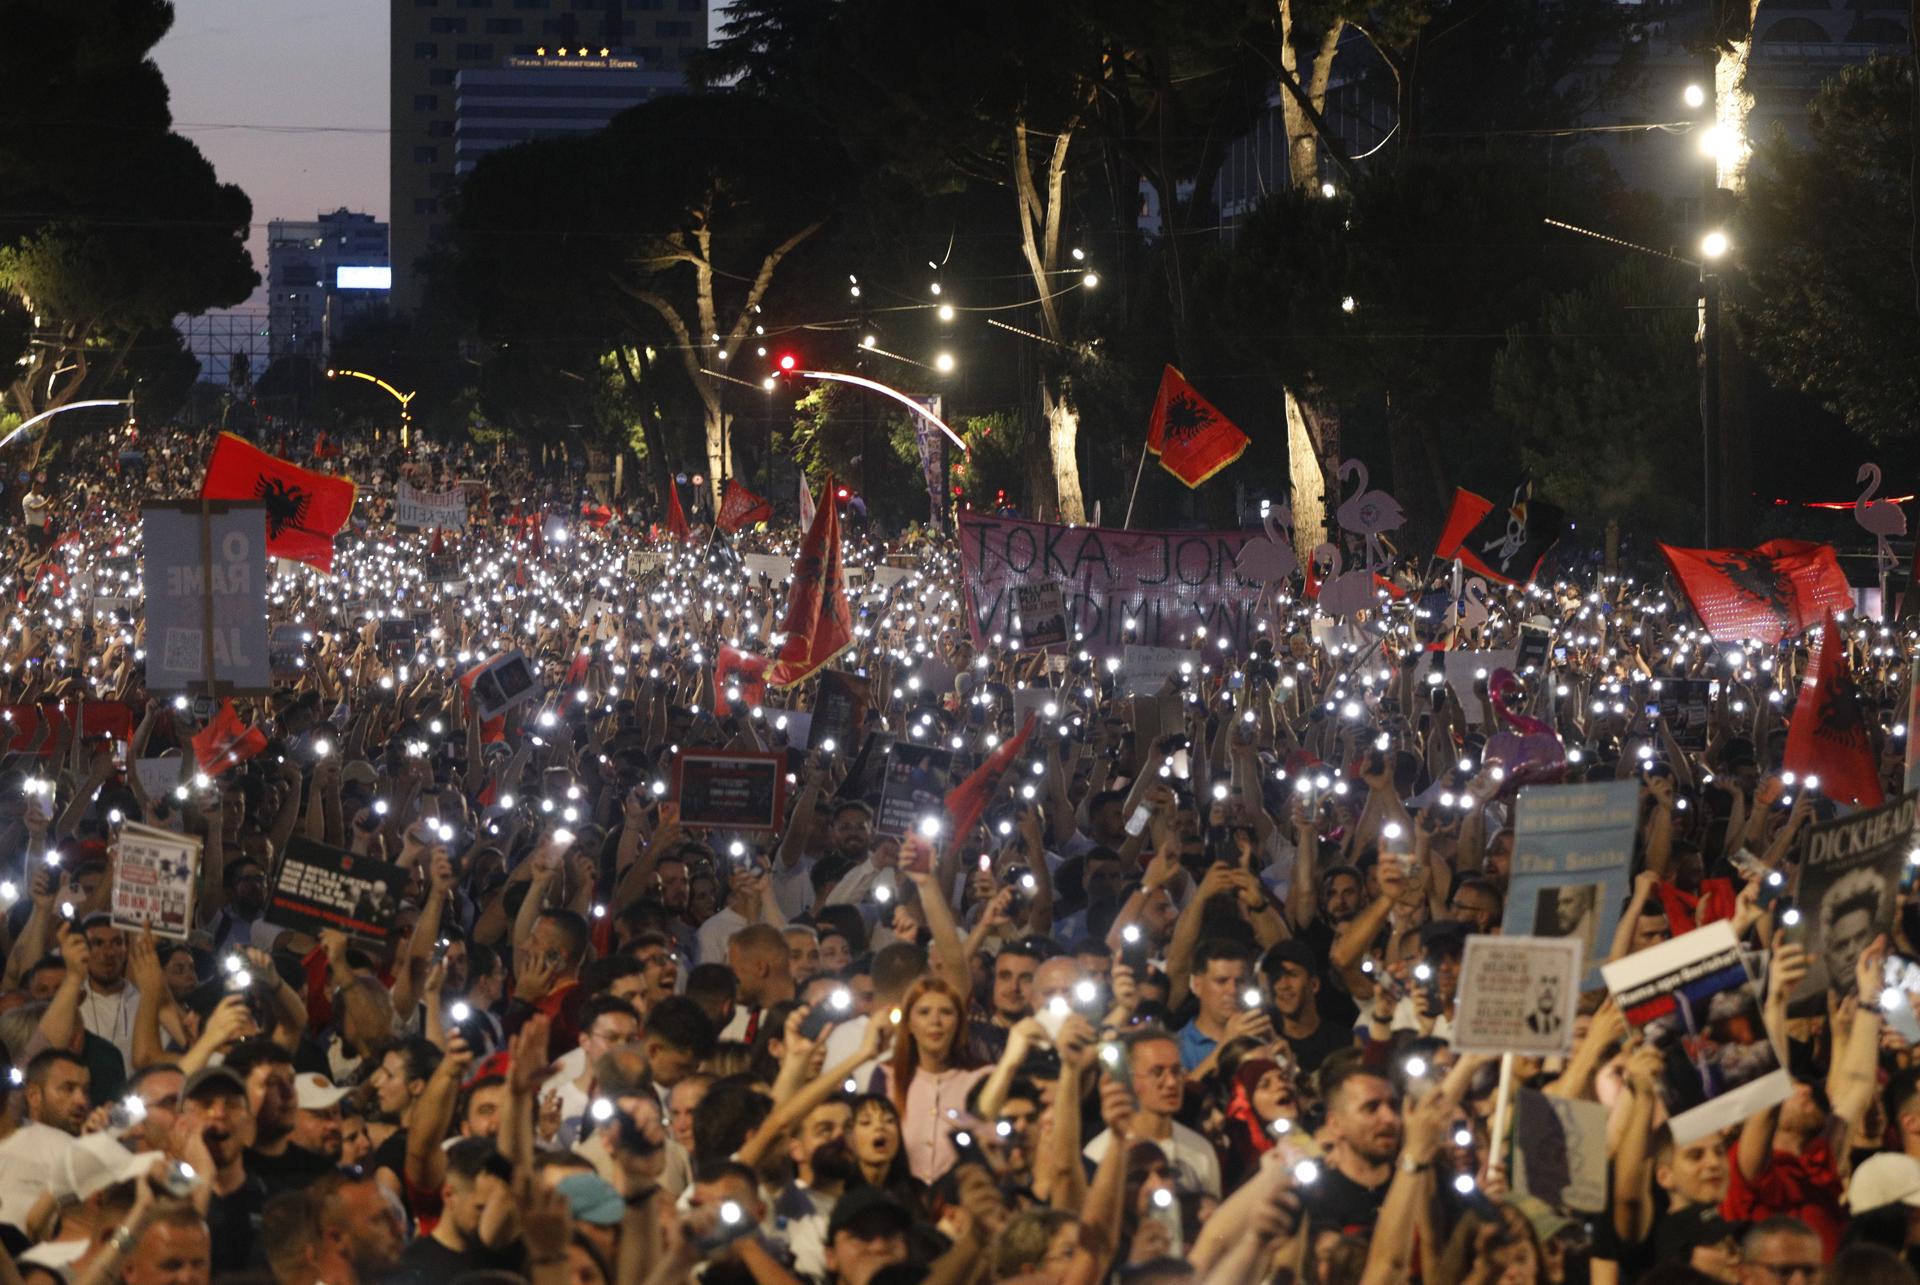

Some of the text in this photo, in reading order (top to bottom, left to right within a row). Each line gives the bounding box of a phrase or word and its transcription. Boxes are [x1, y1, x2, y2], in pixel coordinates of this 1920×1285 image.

[965, 522, 1266, 588] TOKA JON
[972, 585, 1162, 650] VEDIMI
